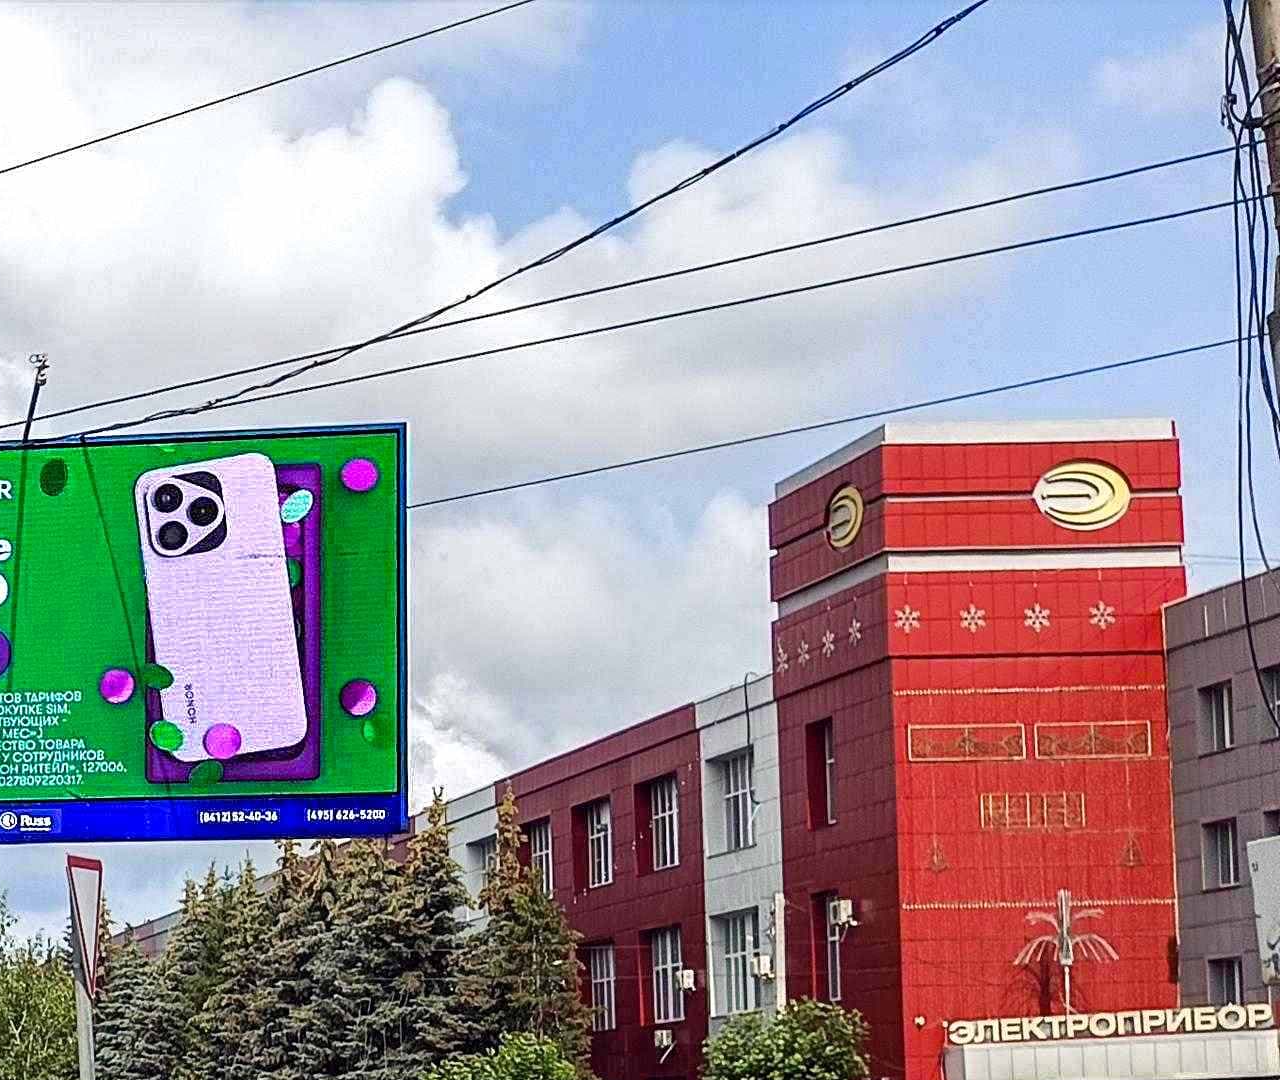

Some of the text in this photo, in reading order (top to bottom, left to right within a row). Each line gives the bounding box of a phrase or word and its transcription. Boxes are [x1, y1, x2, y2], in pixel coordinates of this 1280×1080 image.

[25, 690, 81, 702] ТАРИФОВ
[39, 737, 85, 749] ТОВАРА
[2, 752, 9, 762] У
[13, 749, 104, 761] СОТРУДНИКОВ
[20, 815, 51, 827] Russ
[948, 1003, 1273, 1044] ЭЛЕКТРОПРИБОР
